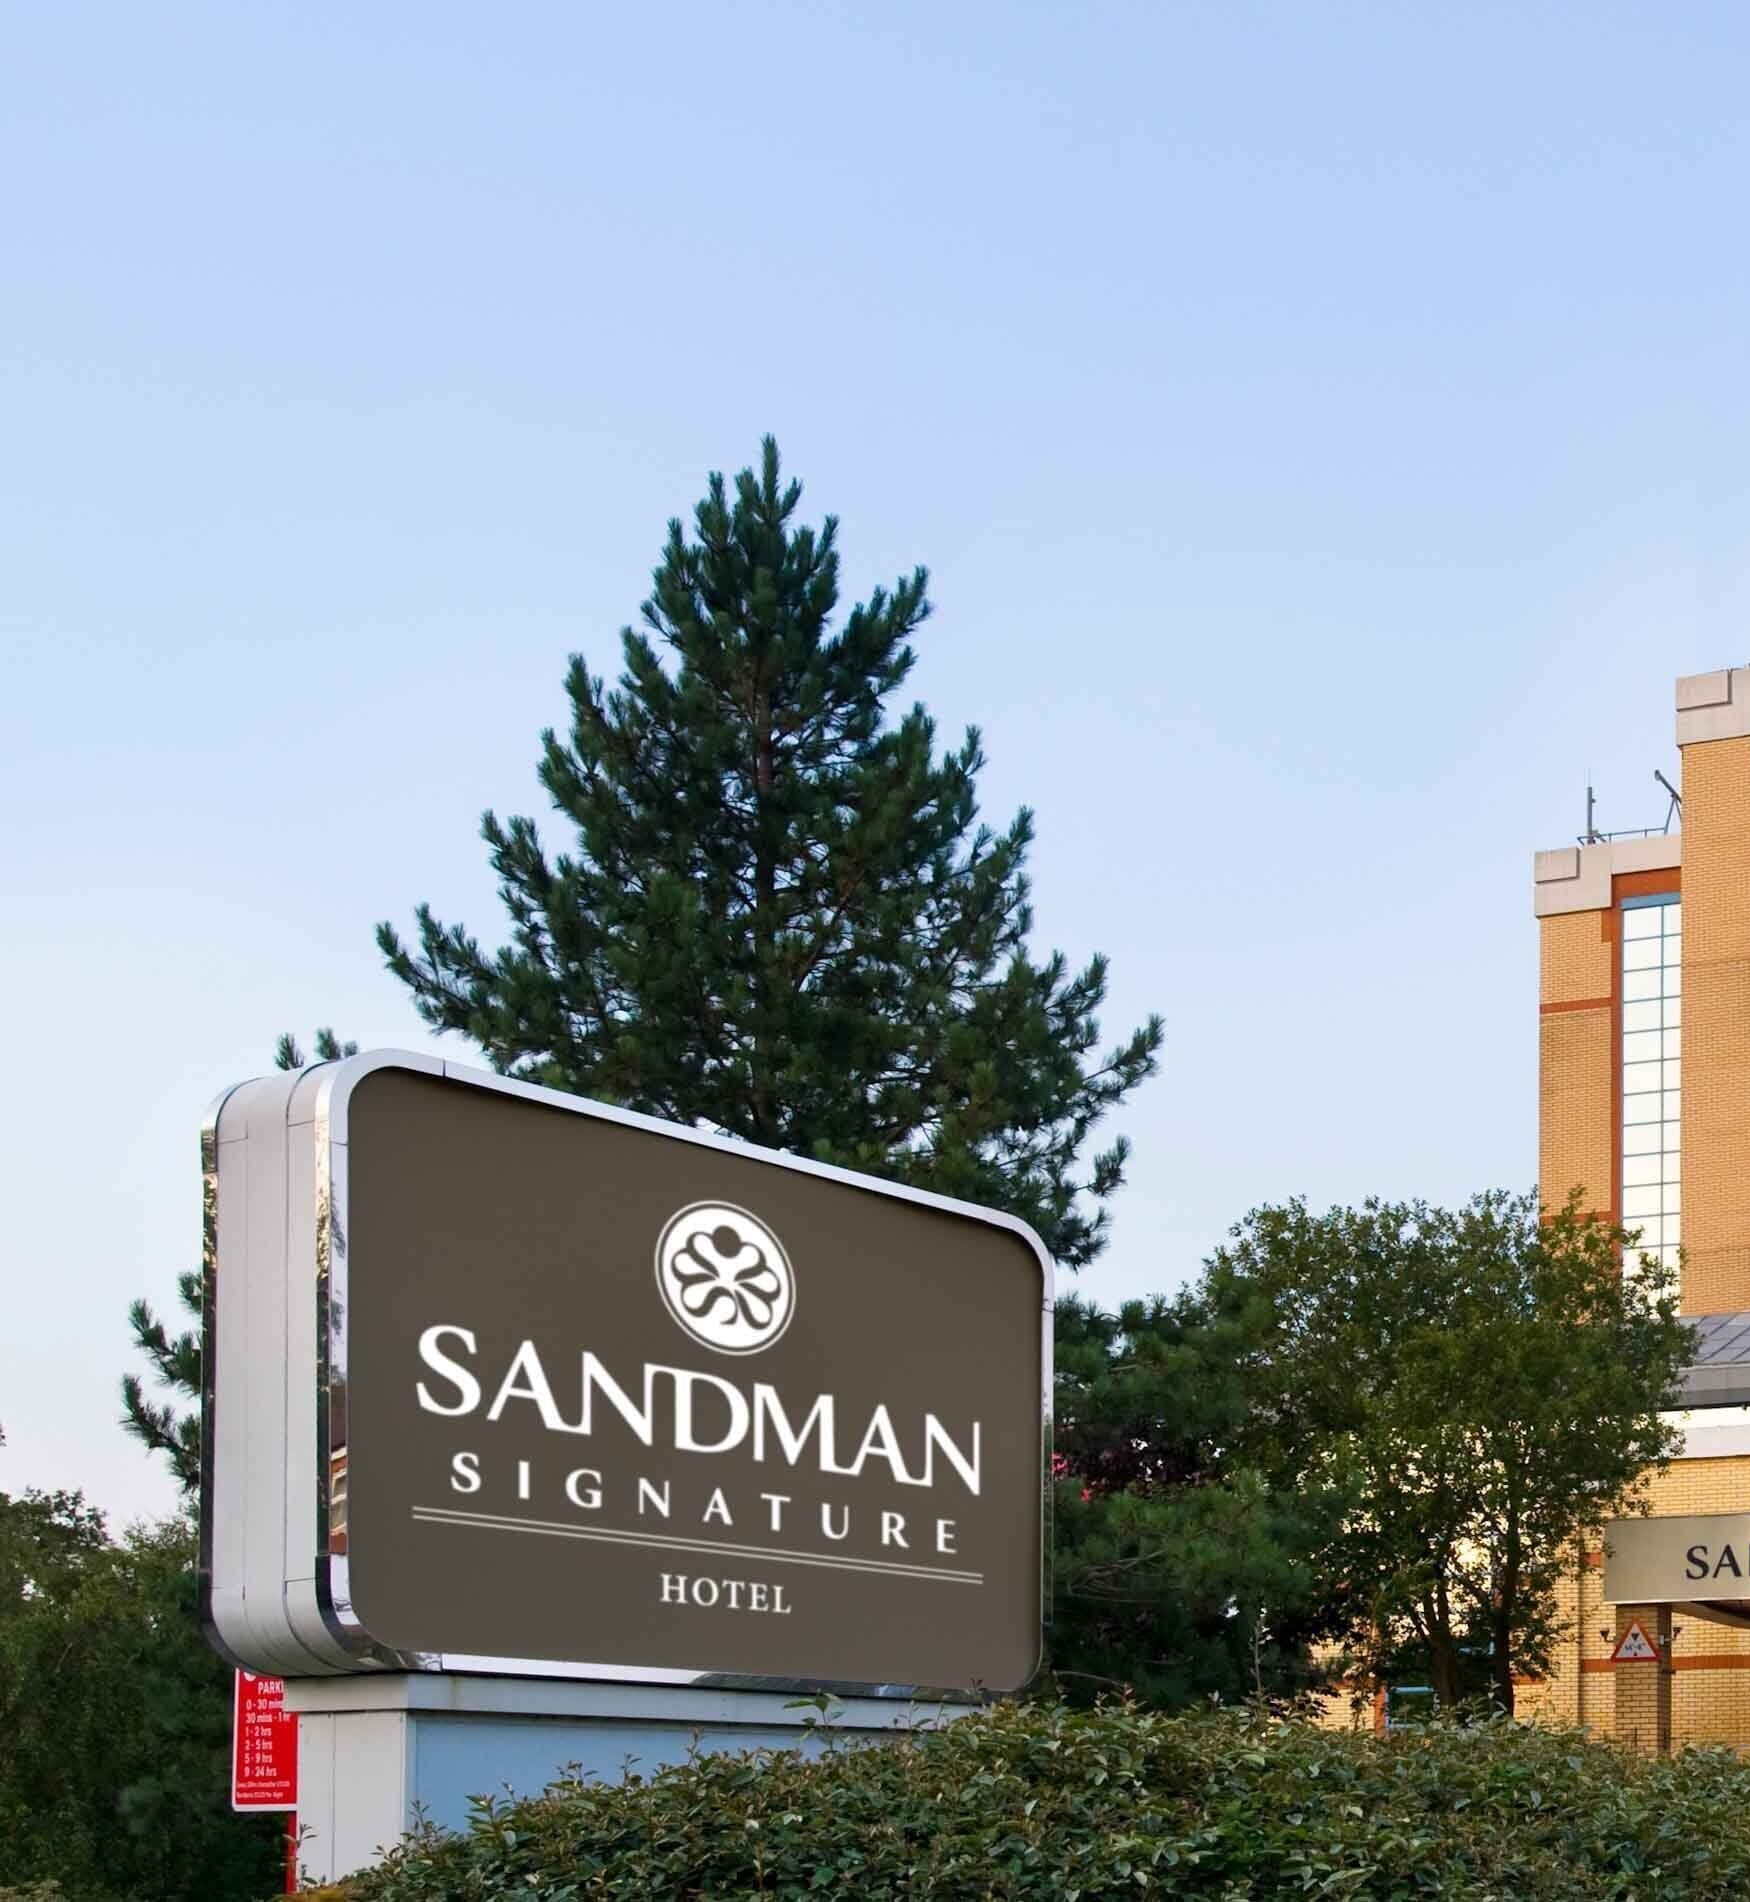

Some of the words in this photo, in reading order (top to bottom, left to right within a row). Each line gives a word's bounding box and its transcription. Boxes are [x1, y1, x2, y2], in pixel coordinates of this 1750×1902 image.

[415, 1323, 982, 1497] SANDMAN
[449, 1451, 957, 1555] SIGNATURE
[660, 1572, 793, 1616] HOTEL
[246, 1699, 252, 1711] 0
[257, 1698, 268, 1710] 30
[245, 1712, 256, 1724] 30
[254, 1726, 260, 1737] 2
[261, 1726, 272, 1737] hrs
[245, 1739, 250, 1751] 2
[255, 1739, 261, 1750] 5
[262, 1738, 273, 1750] hrs
[255, 1752, 261, 1764] 9
[262, 1752, 273, 1764] hrs
[254, 1766, 265, 1777] 24
[265, 1766, 277, 1777] hrs
